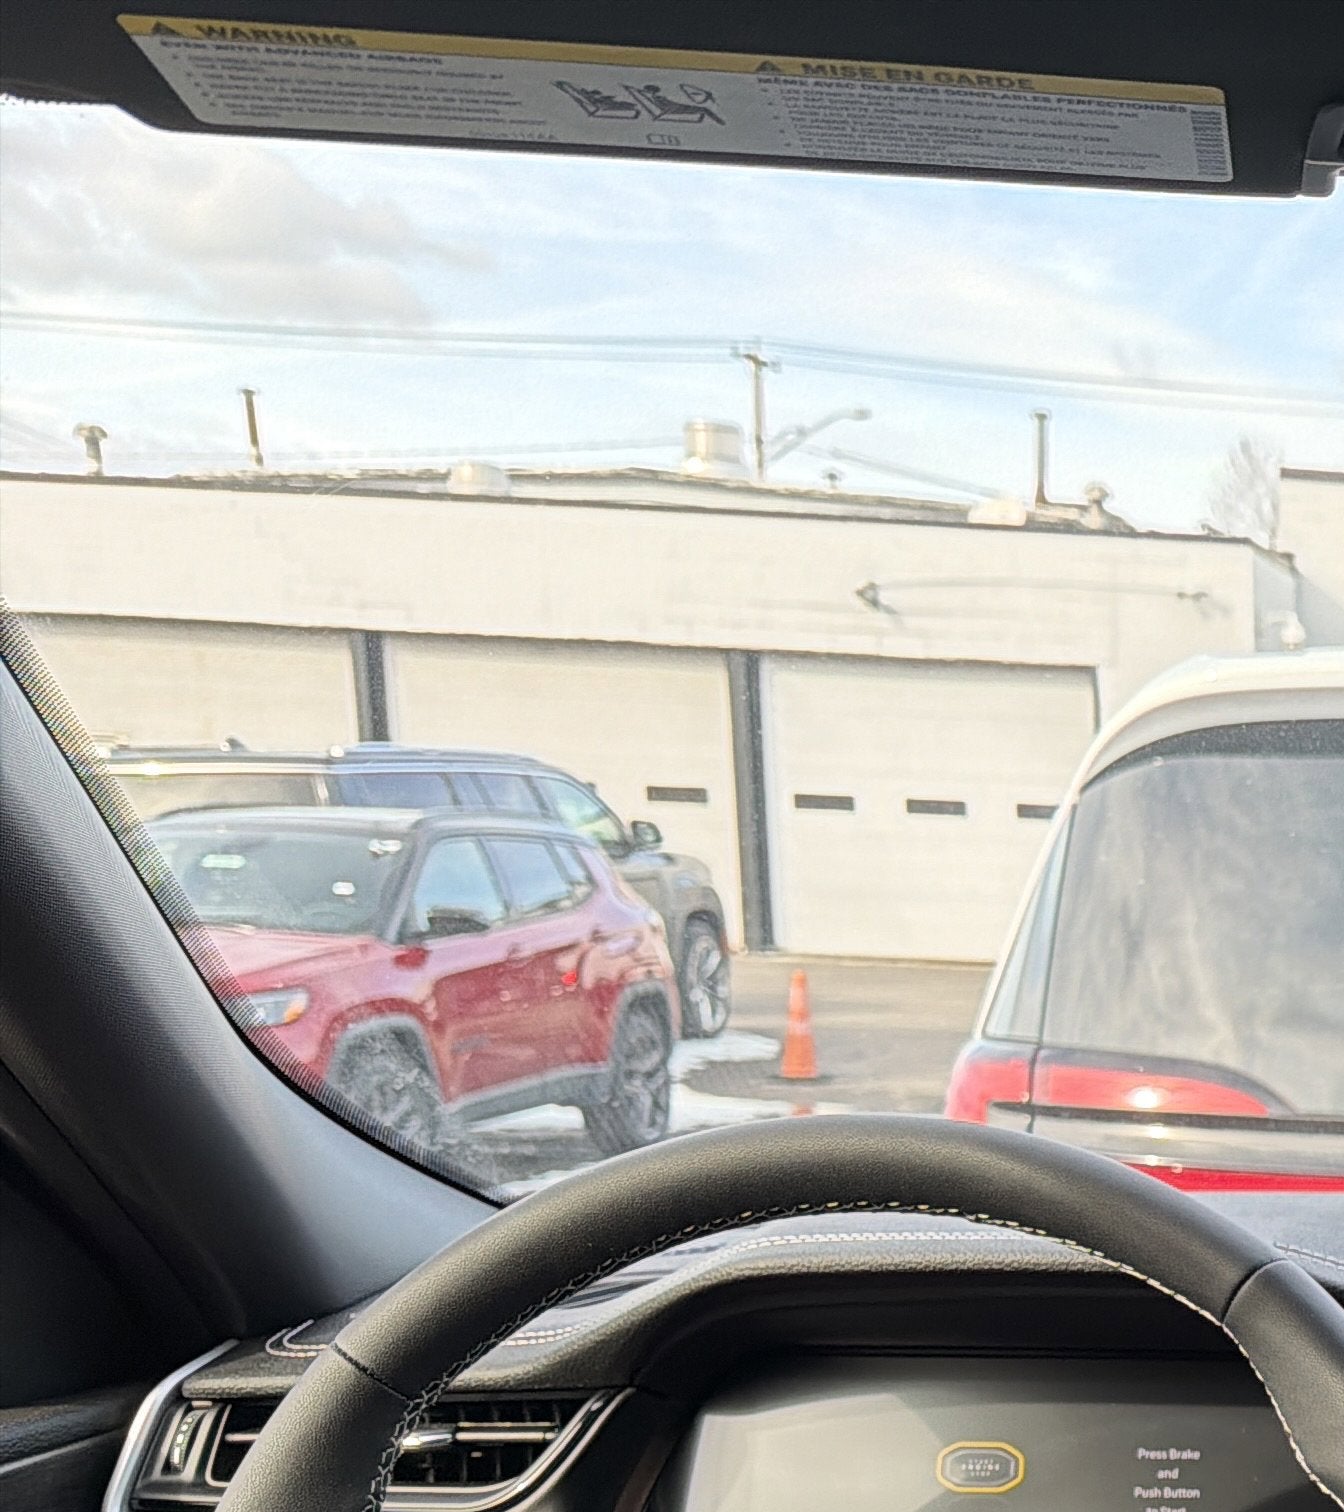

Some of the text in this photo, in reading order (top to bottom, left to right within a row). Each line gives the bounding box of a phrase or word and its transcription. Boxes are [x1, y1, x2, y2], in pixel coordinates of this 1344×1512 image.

[195, 23, 359, 48] WARNING
[801, 62, 1035, 91] MISE EN GARDE
[1137, 1447, 1200, 1460] Press Brake
[1157, 1467, 1179, 1480] and
[1134, 1486, 1201, 1499] Push Button
